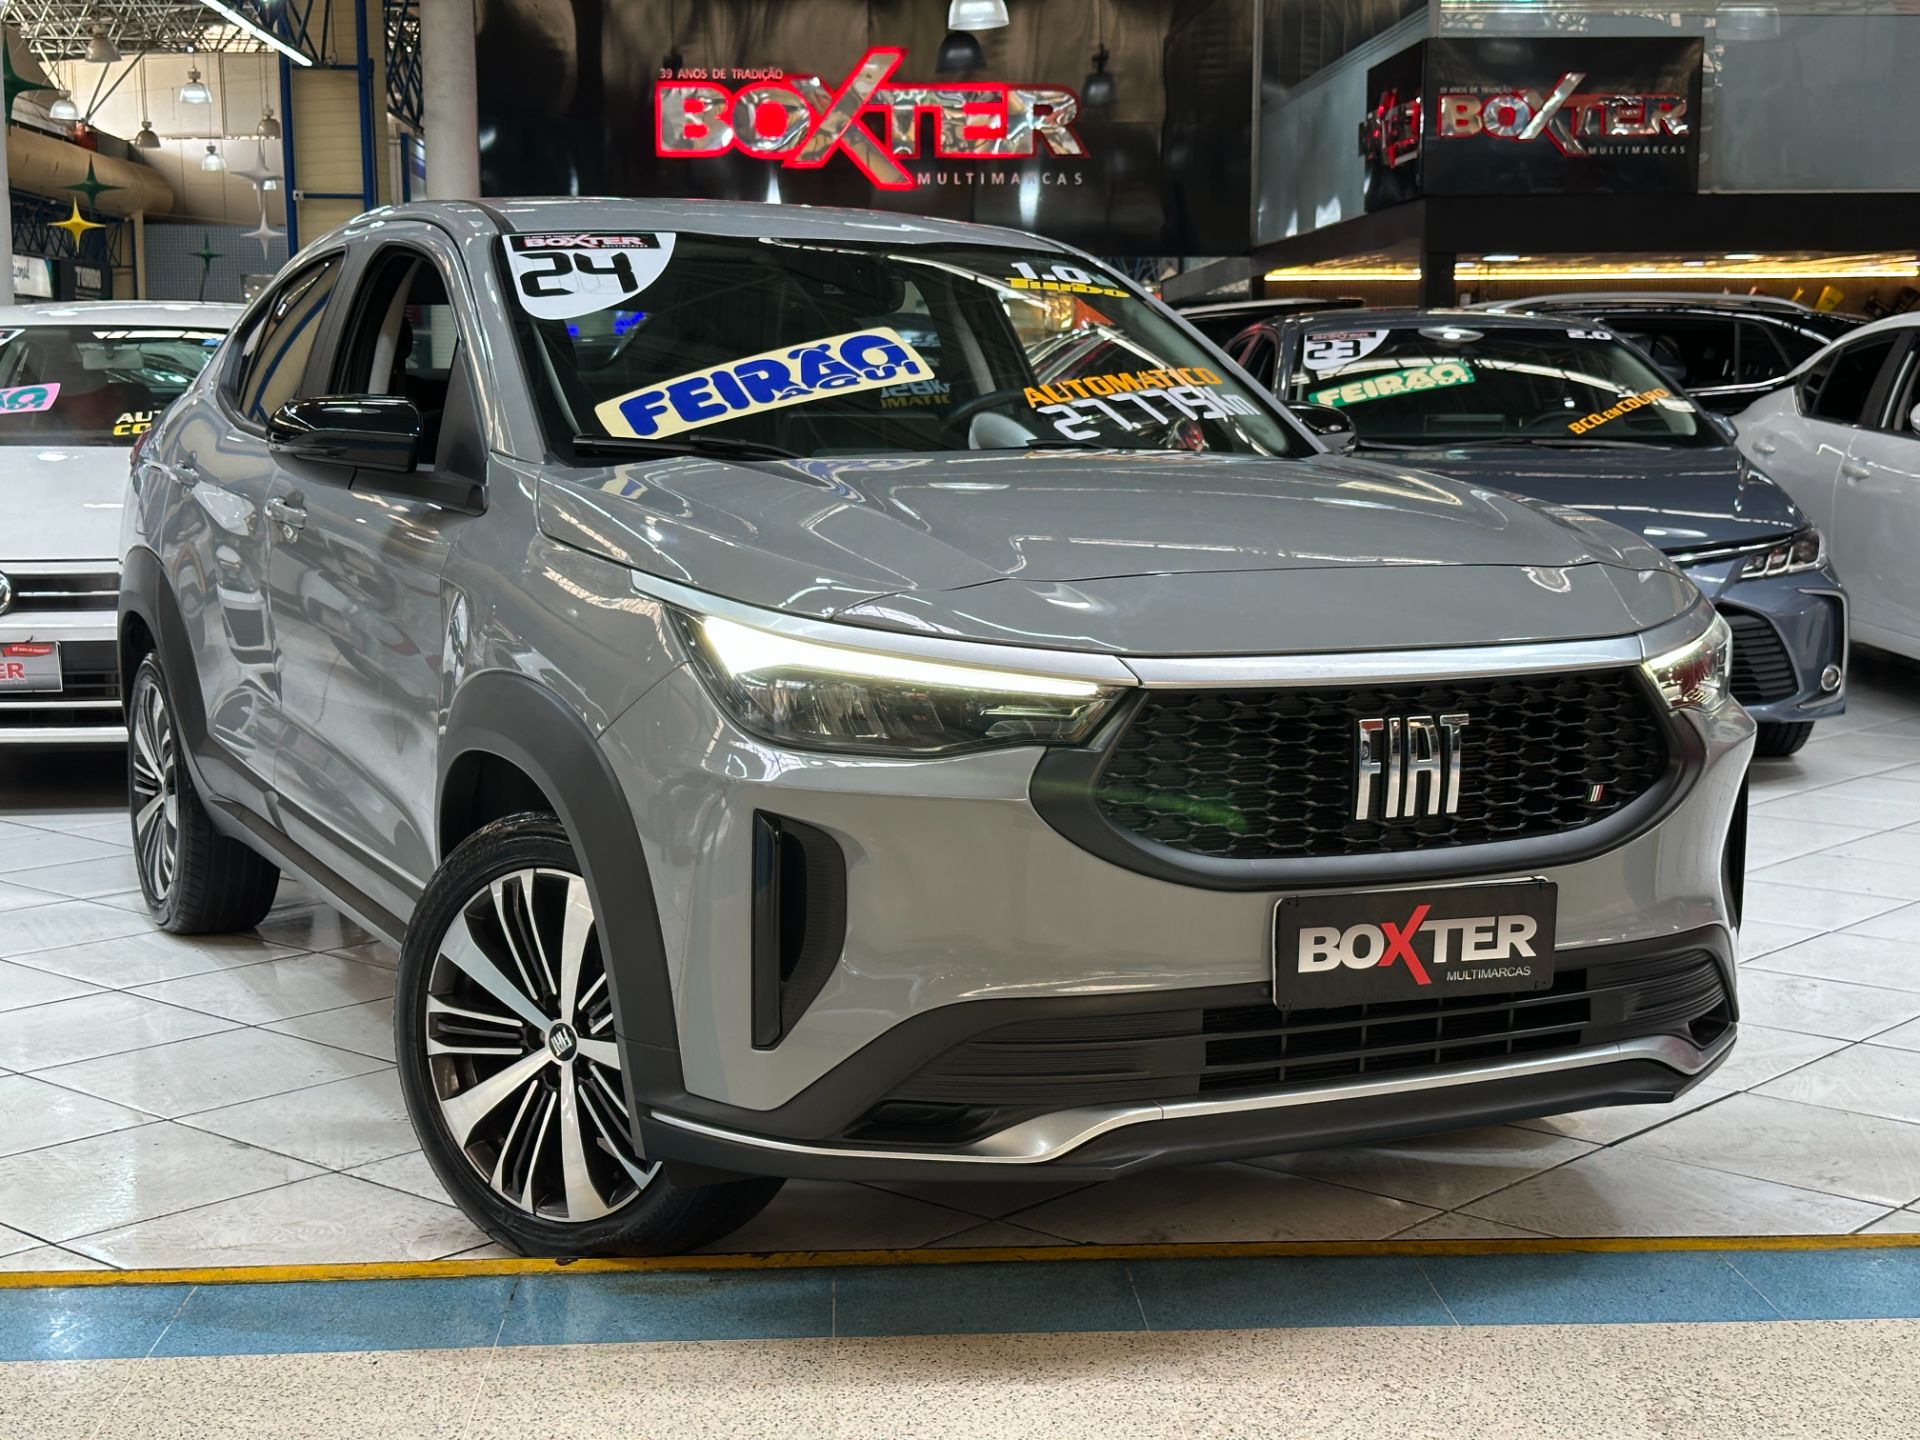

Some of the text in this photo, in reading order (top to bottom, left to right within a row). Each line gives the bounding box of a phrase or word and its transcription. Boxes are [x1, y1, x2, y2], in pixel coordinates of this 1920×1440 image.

[659, 66, 784, 81] 39 ANOS DE TRADIÇÃO
[655, 47, 1090, 190] BOXTER
[1437, 72, 1688, 157] BOXTER
[1587, 145, 1686, 156] MULTIMARCAS
[917, 171, 1083, 185] MULTIMARCAS
[523, 233, 644, 249] BOXTER
[519, 251, 639, 298] 24
[1011, 261, 1092, 285] 1.0
[1307, 339, 1361, 360] 23
[1566, 329, 1612, 340] 2.0
[619, 334, 911, 437] FEIRÃO
[777, 360, 919, 401] AQUI
[1316, 363, 1466, 407] FEIRÃO
[1355, 713, 1470, 820] FIAT
[1298, 904, 1538, 985] BOXTER
[1446, 965, 1532, 981] MULTIMARCAS
